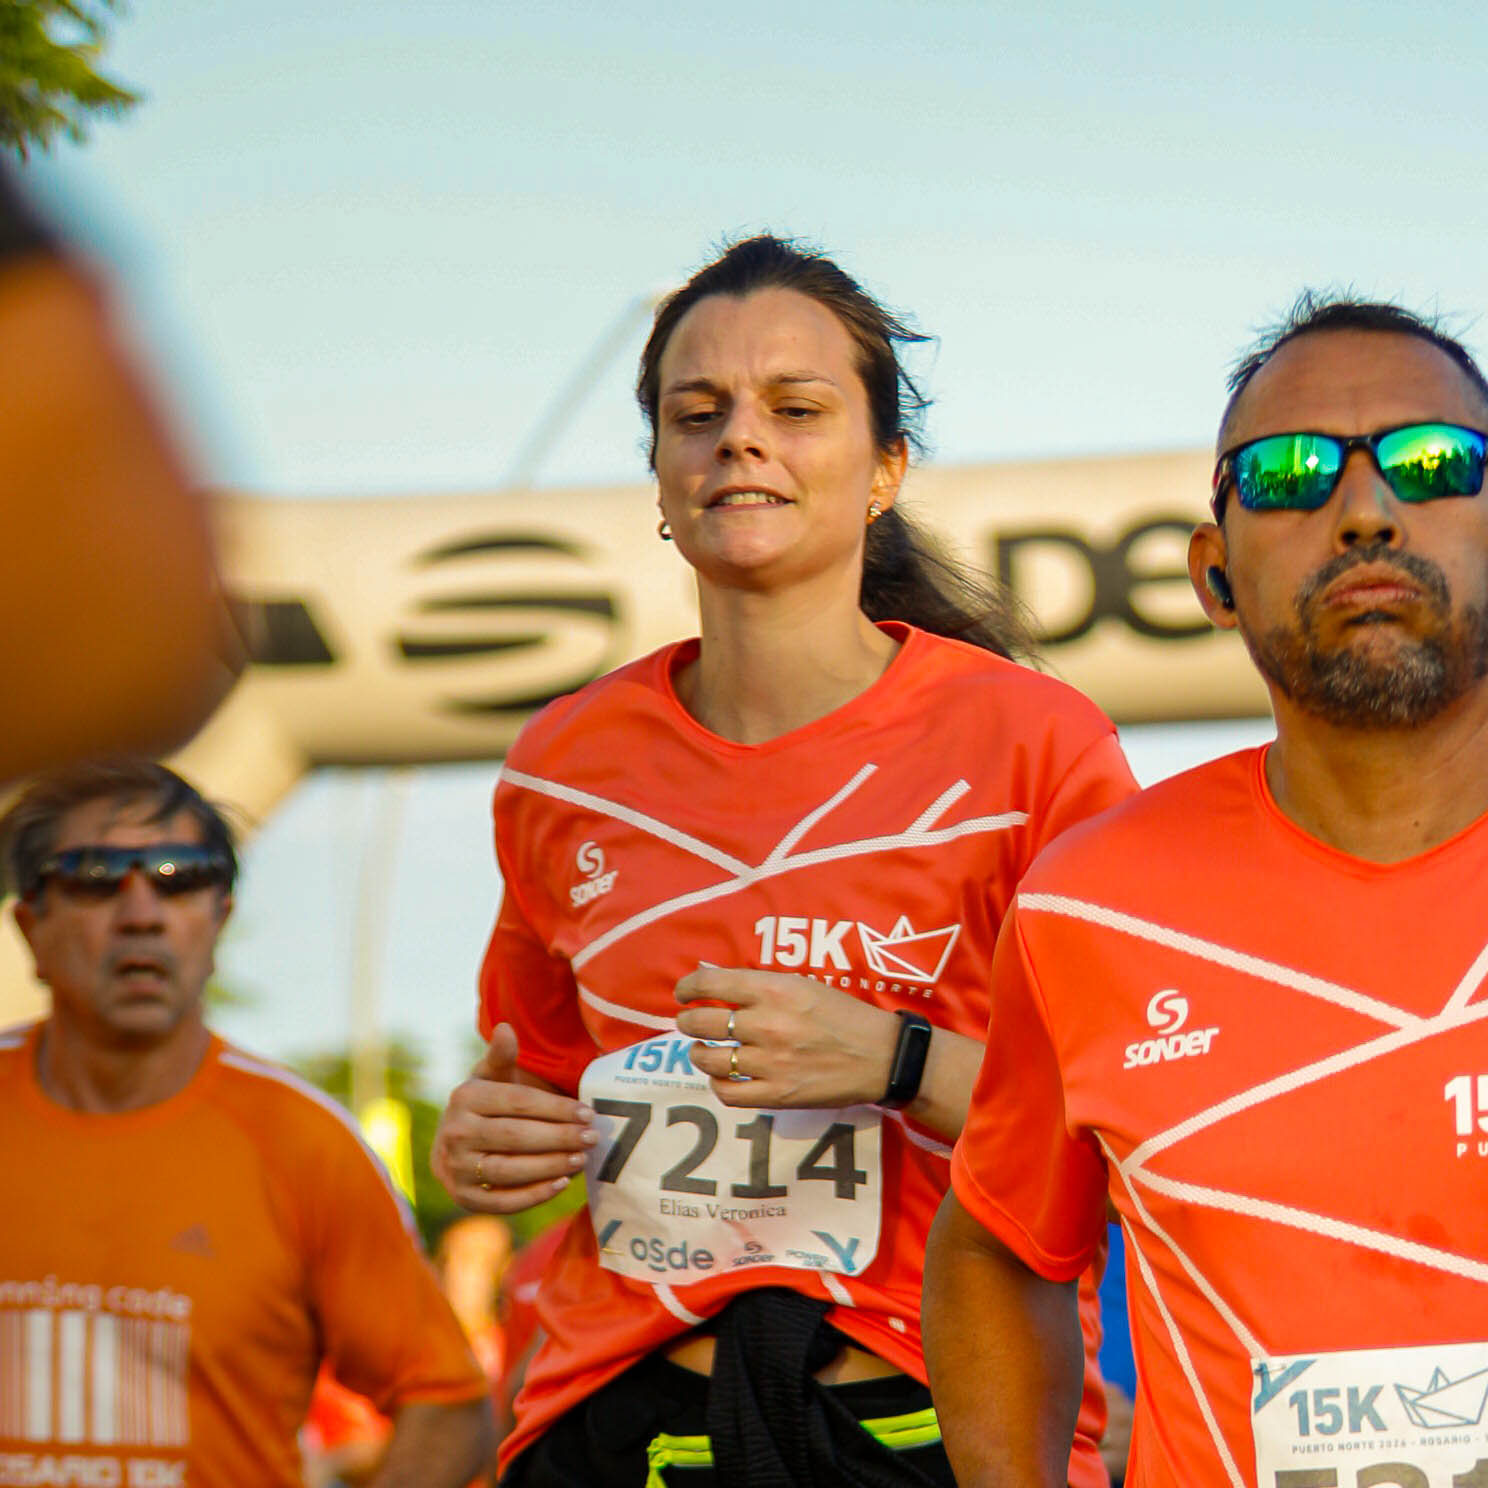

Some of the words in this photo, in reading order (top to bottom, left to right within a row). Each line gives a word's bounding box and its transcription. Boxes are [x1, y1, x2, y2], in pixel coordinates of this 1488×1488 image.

[754, 915, 854, 971] 15K
[859, 977, 934, 999] NORTE
[623, 1039, 695, 1076] 15K
[591, 1097, 868, 1200] 7214
[629, 1237, 714, 1272] osde
[1289, 1384, 1388, 1437] 15K
[1292, 1443, 1333, 1454] PUERTO
[1338, 1441, 1375, 1452] NORTE
[1420, 1435, 1471, 1446] ROSARIO
